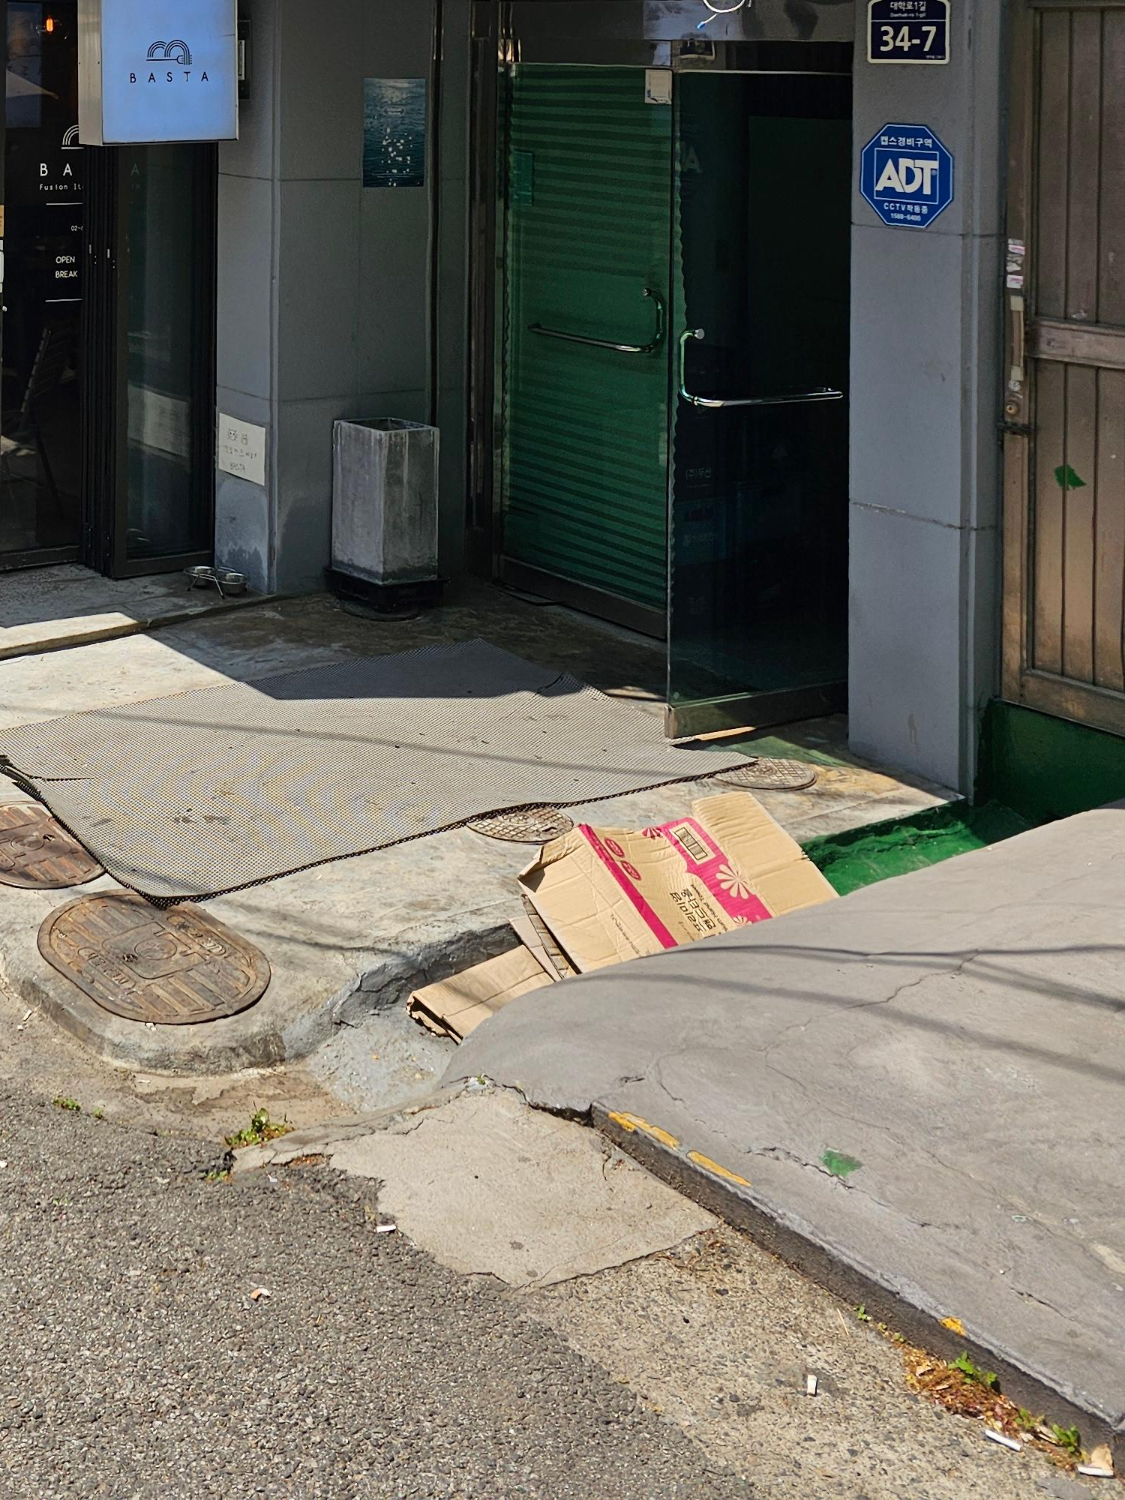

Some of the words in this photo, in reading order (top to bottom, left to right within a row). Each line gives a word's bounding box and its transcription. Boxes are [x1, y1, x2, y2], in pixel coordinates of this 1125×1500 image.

[890, 1, 927, 11] 대학로1길
[880, 25, 937, 52] 34-7
[129, 71, 209, 84] BASTA
[875, 157, 939, 195] ADT
[39, 183, 69, 191] Fusion
[55, 256, 76, 264] OPEN
[55, 270, 78, 278] BREAK
